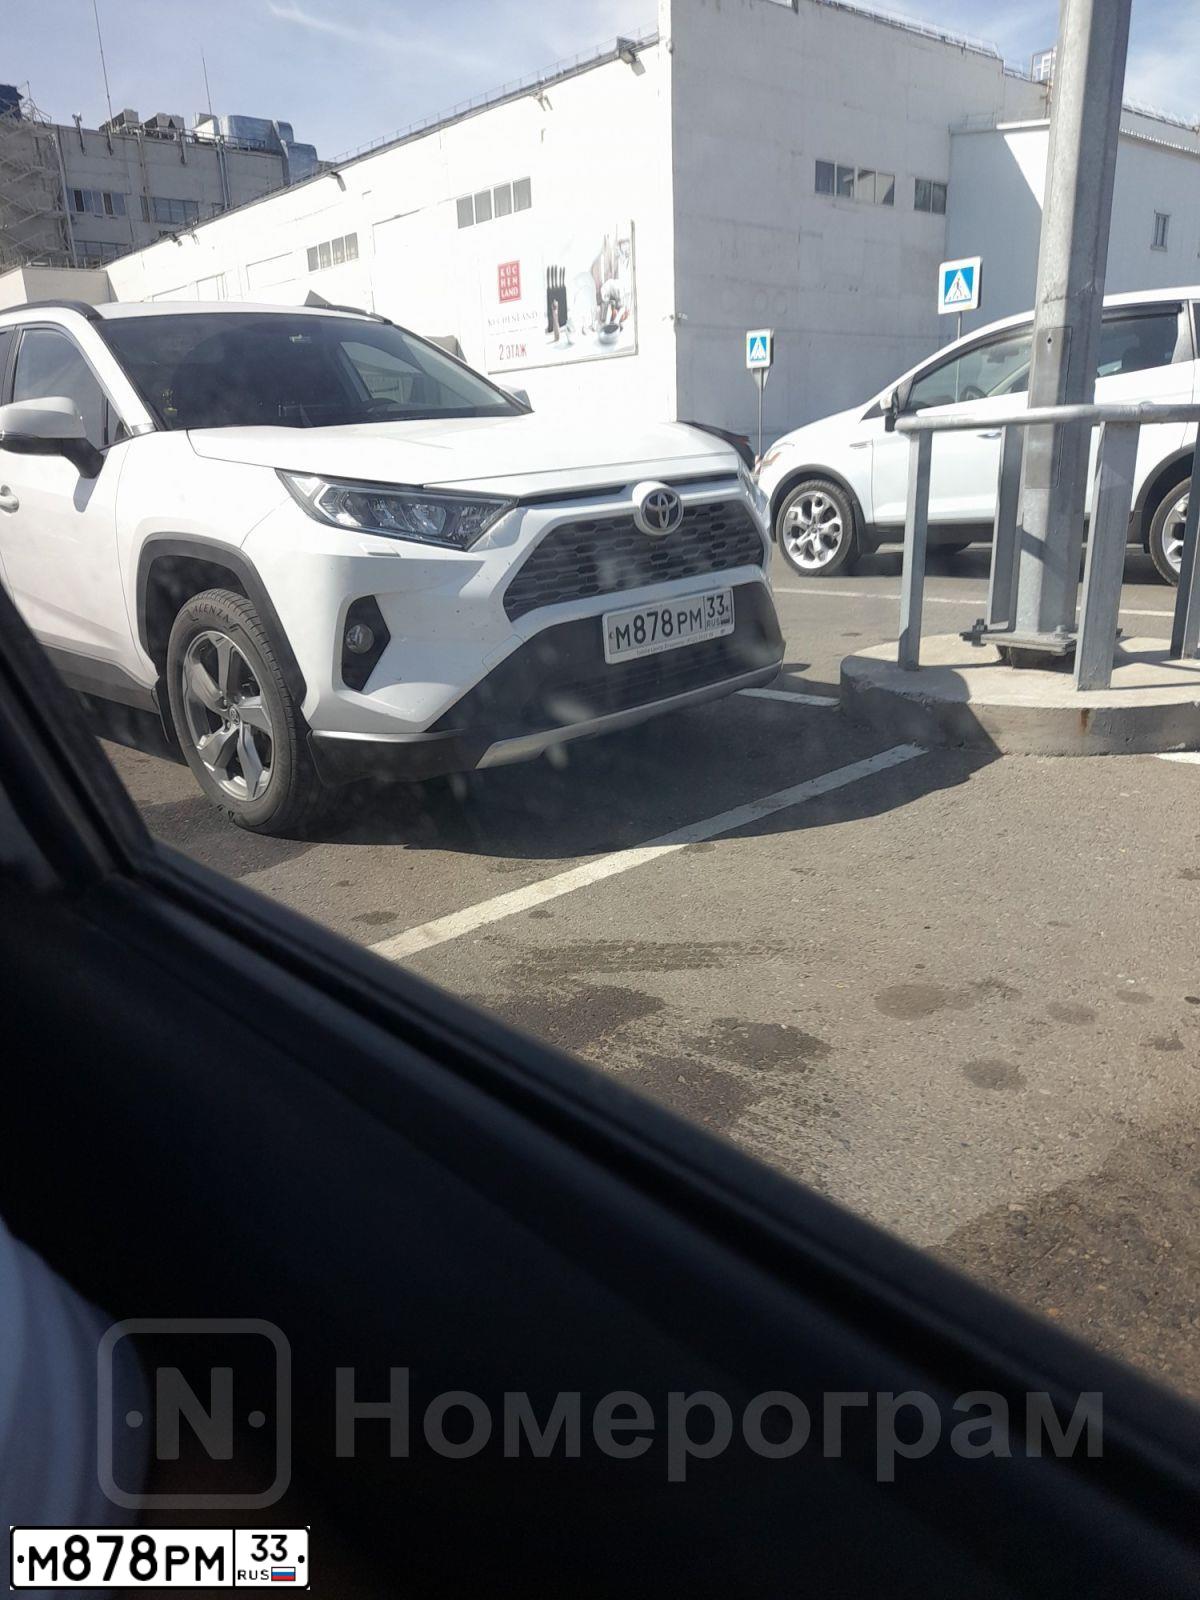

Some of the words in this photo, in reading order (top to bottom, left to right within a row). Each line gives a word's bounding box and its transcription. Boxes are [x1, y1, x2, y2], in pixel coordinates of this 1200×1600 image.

[501, 286, 519, 298] LAND
[498, 344, 505, 361] 2
[506, 343, 528, 360] ЭТАЖ
[706, 595, 725, 618] 33
[706, 620, 721, 629] RUS
